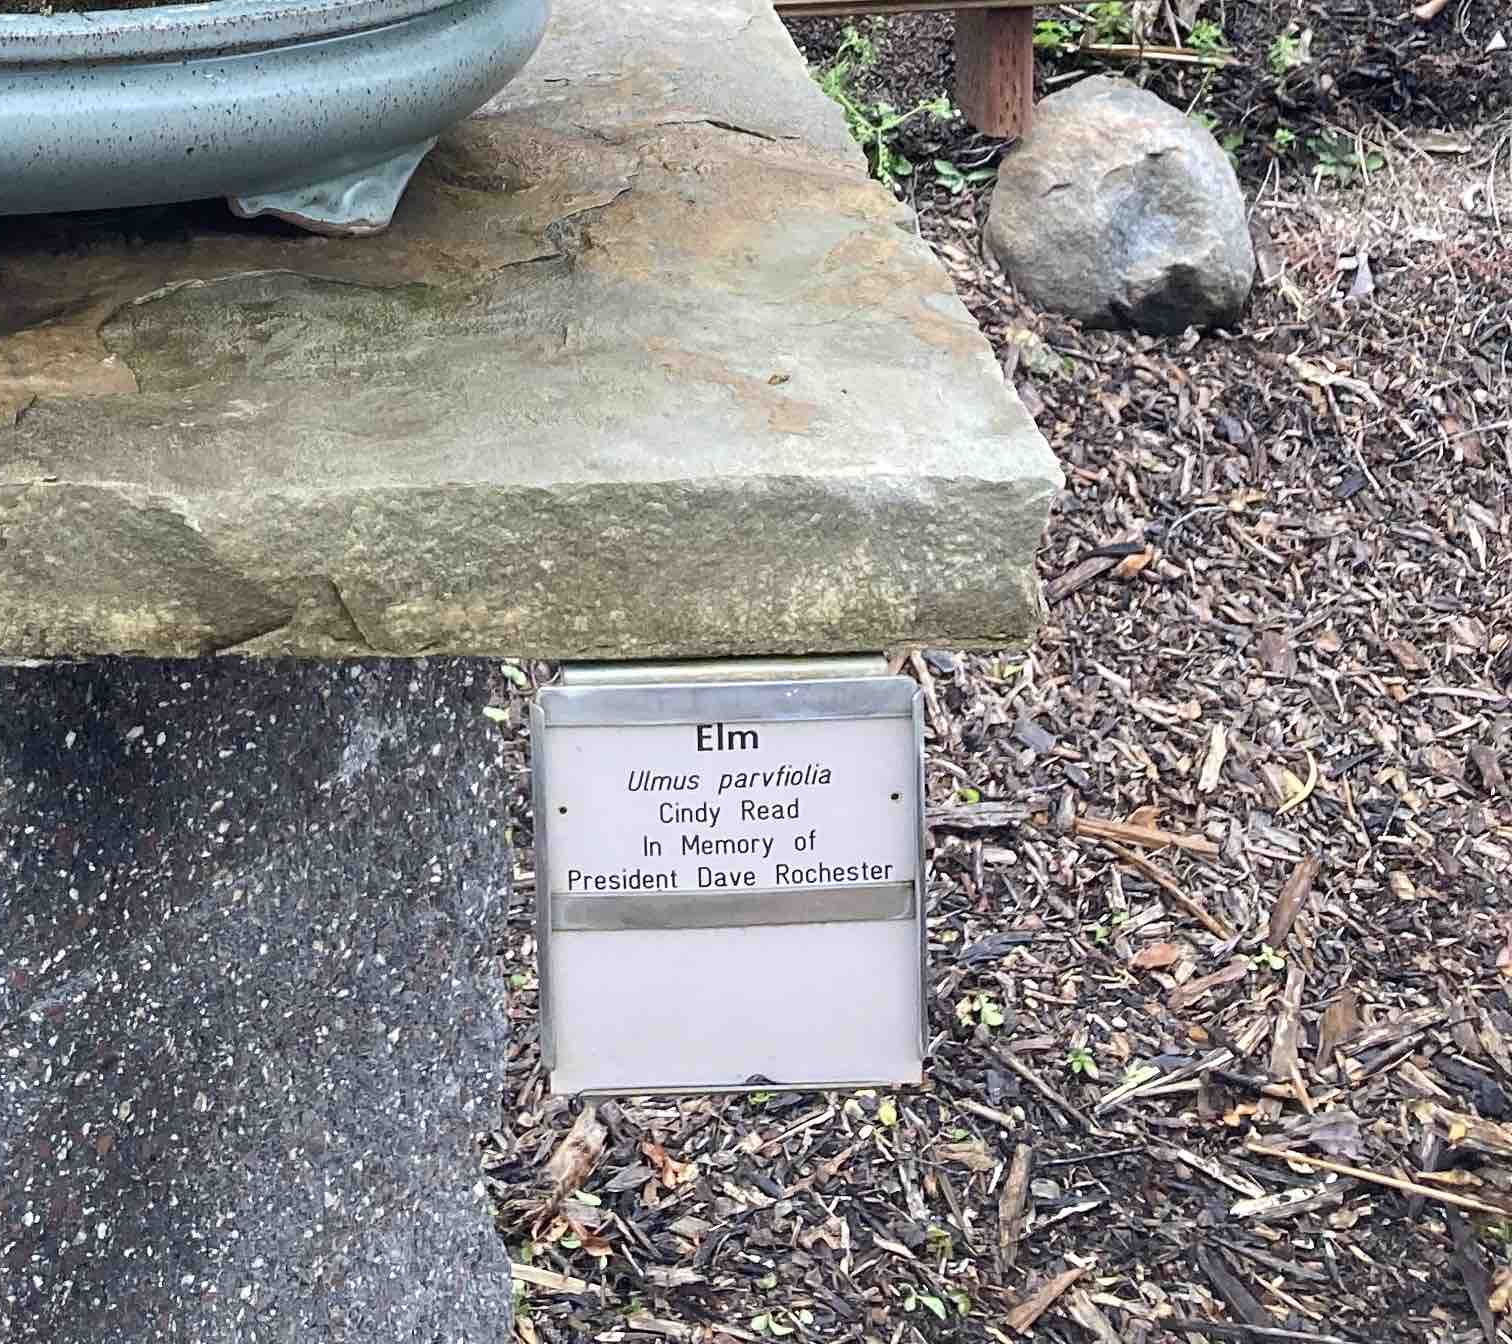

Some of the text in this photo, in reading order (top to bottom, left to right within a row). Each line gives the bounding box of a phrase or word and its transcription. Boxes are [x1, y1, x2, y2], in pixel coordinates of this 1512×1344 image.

[696, 723, 759, 752] Elm
[627, 763, 832, 795] Ulmus parvfiolia
[659, 797, 800, 828] Cindy Read
[643, 829, 817, 858] In Memory of
[568, 861, 894, 891] President Dave Rochester
